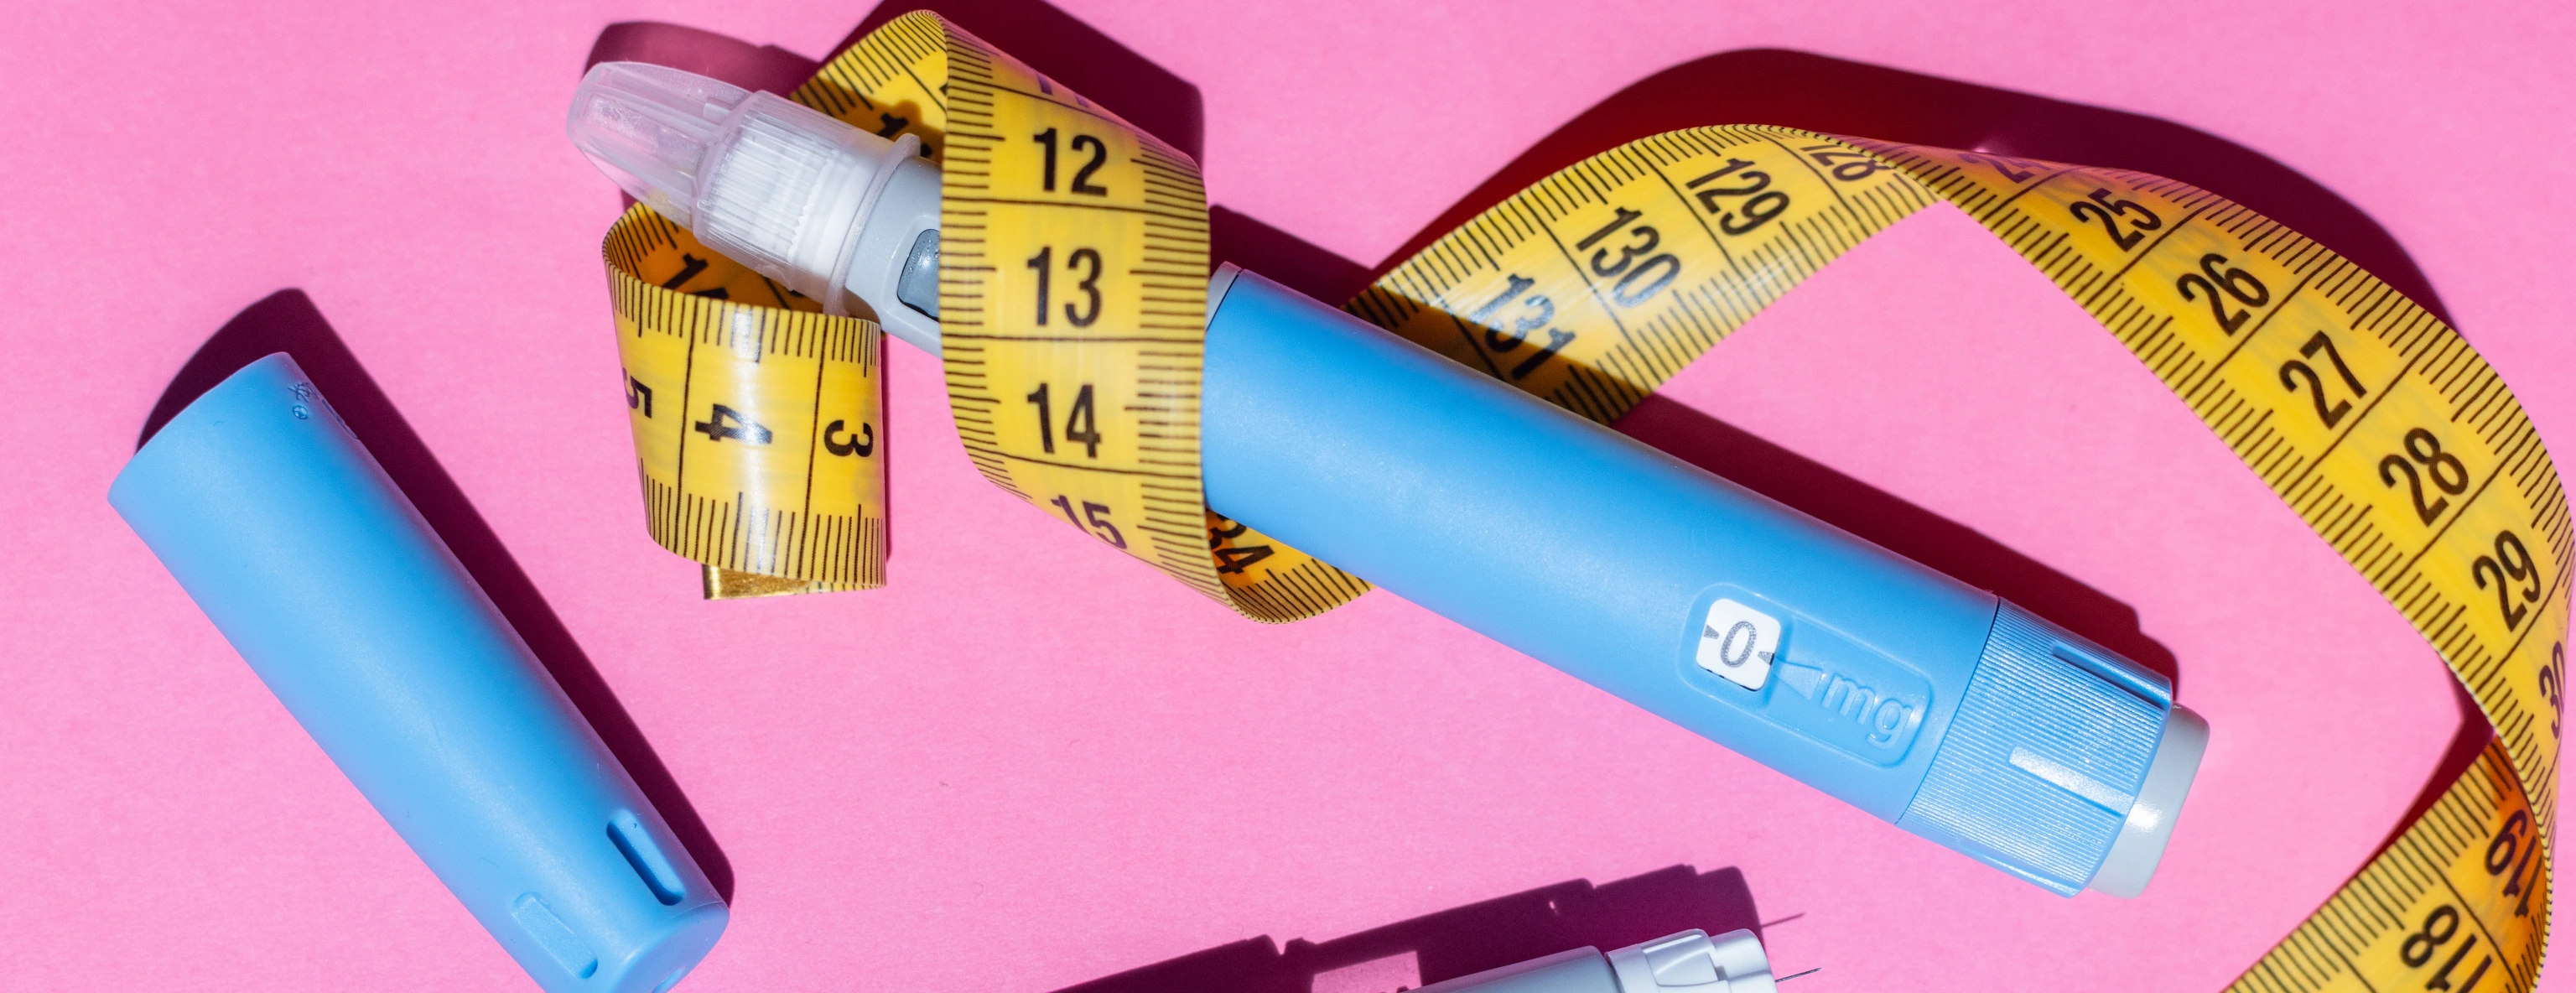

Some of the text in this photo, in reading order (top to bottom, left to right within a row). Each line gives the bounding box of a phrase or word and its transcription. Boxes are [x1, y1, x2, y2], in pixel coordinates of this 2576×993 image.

[1032, 127, 1108, 197] 12
[1685, 158, 1789, 236] 129
[1576, 206, 1680, 308] 130
[2070, 187, 2162, 252] 25
[1026, 246, 1103, 328] 13
[1472, 274, 1576, 379] 131
[2176, 252, 2270, 337] 26
[621, 368, 652, 419] 5
[1026, 382, 1102, 459] 14
[2278, 330, 2367, 429] 27
[694, 403, 773, 444] 4
[823, 419, 874, 458] 3
[2378, 427, 2470, 528] 28
[1051, 494, 1128, 550] 15
[2471, 529, 2541, 633] 29
[1720, 621, 1914, 750] 0 mg
[2538, 640, 2566, 740] 30
[2485, 809, 2542, 919] 119
[2400, 904, 2493, 993] 118
